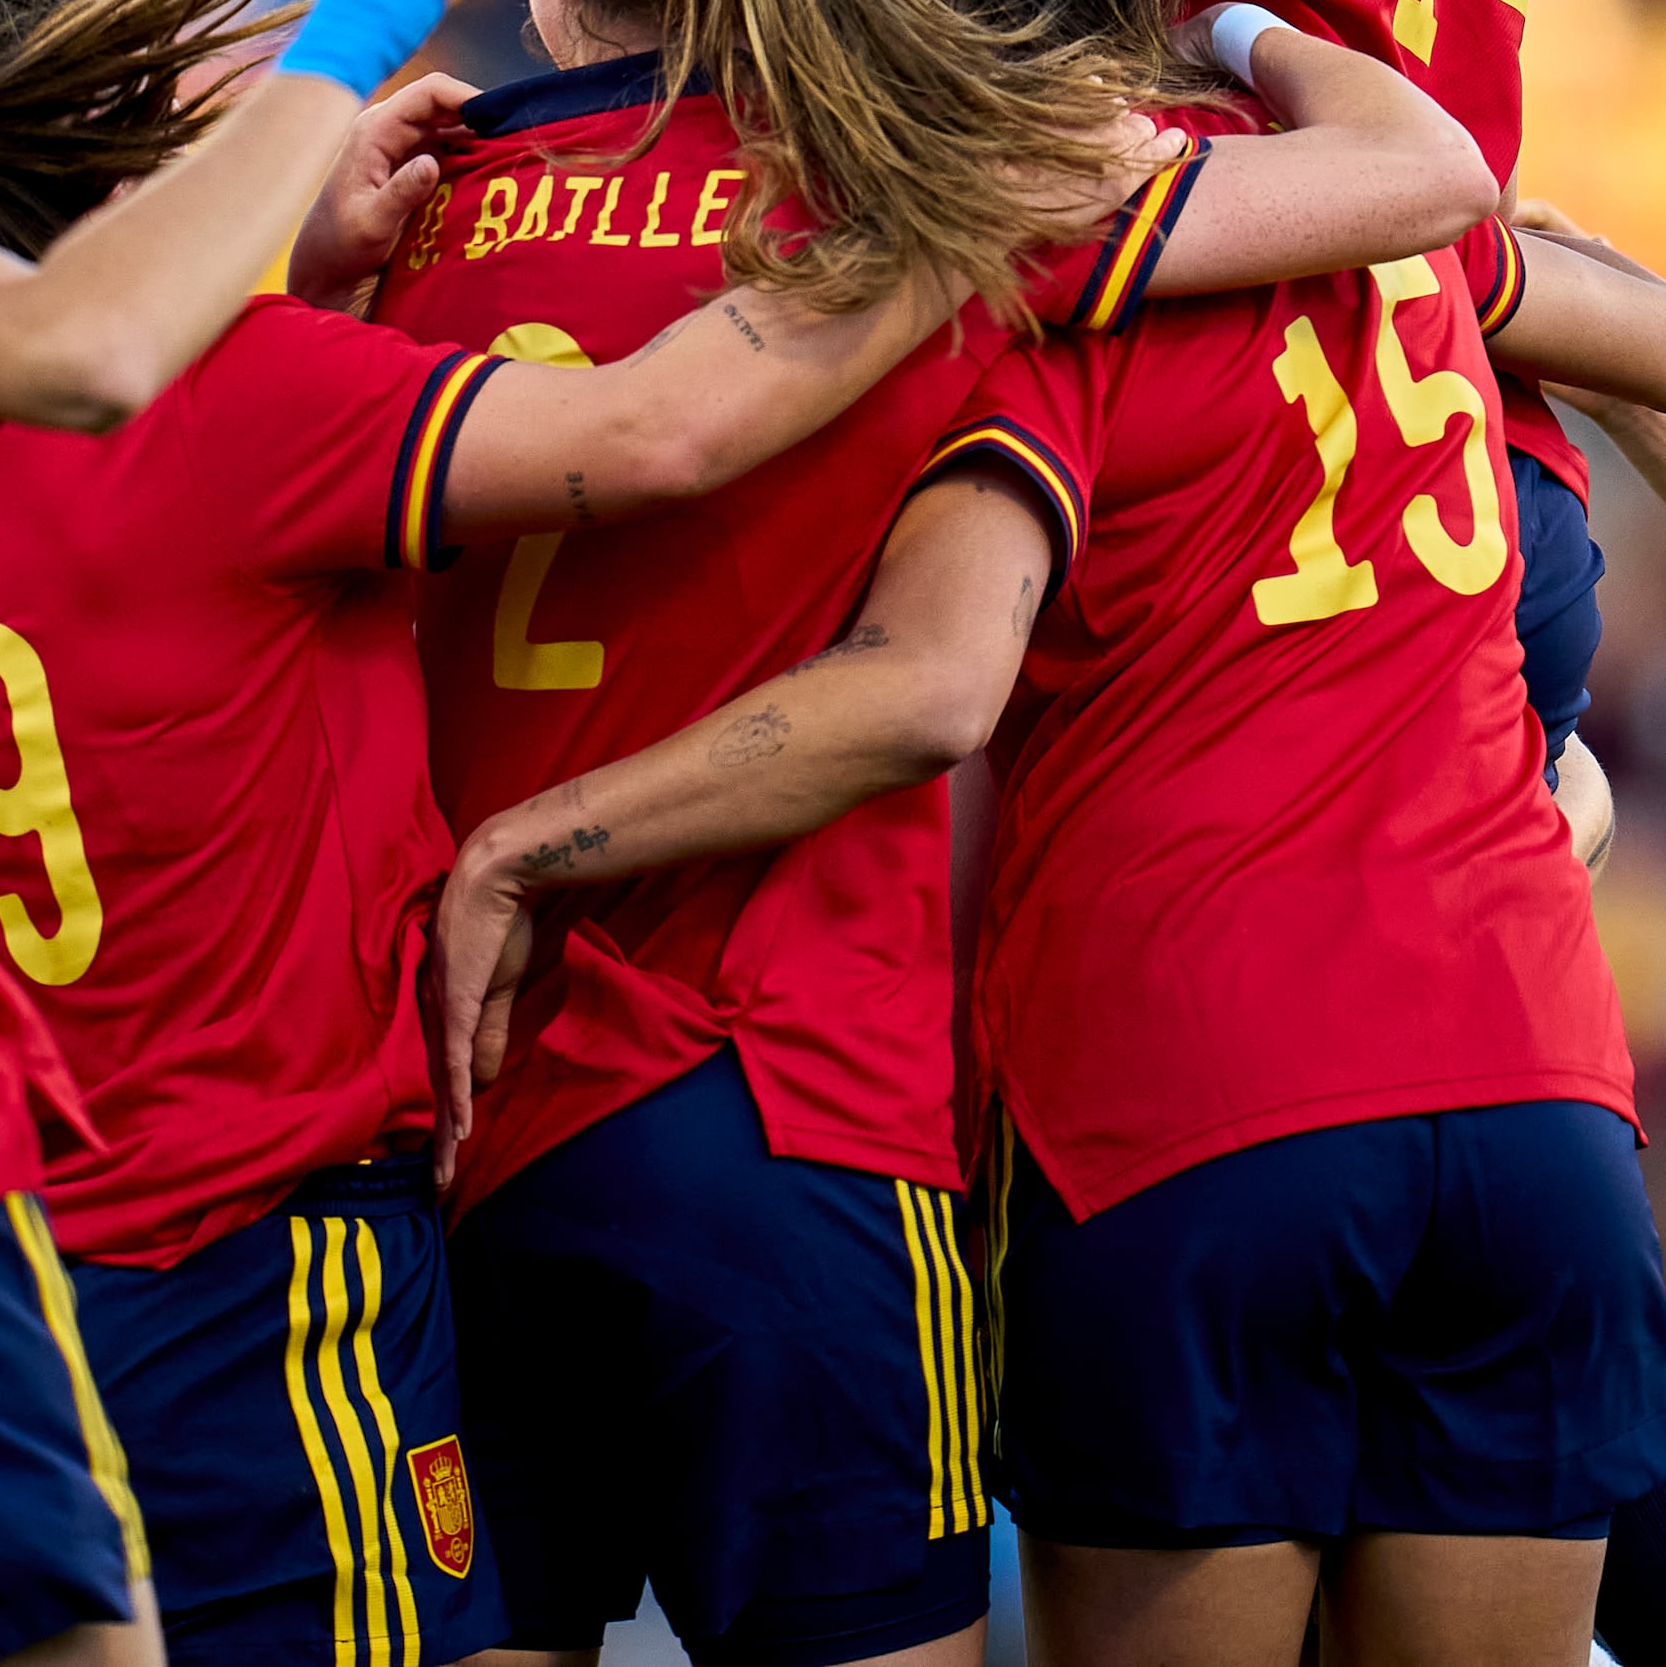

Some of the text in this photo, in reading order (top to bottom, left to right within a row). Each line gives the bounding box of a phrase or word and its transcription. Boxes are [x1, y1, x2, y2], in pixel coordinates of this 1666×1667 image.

[463, 169, 749, 261] BATLLE
[486, 322, 606, 691] 2
[1251, 254, 1509, 626] 15
